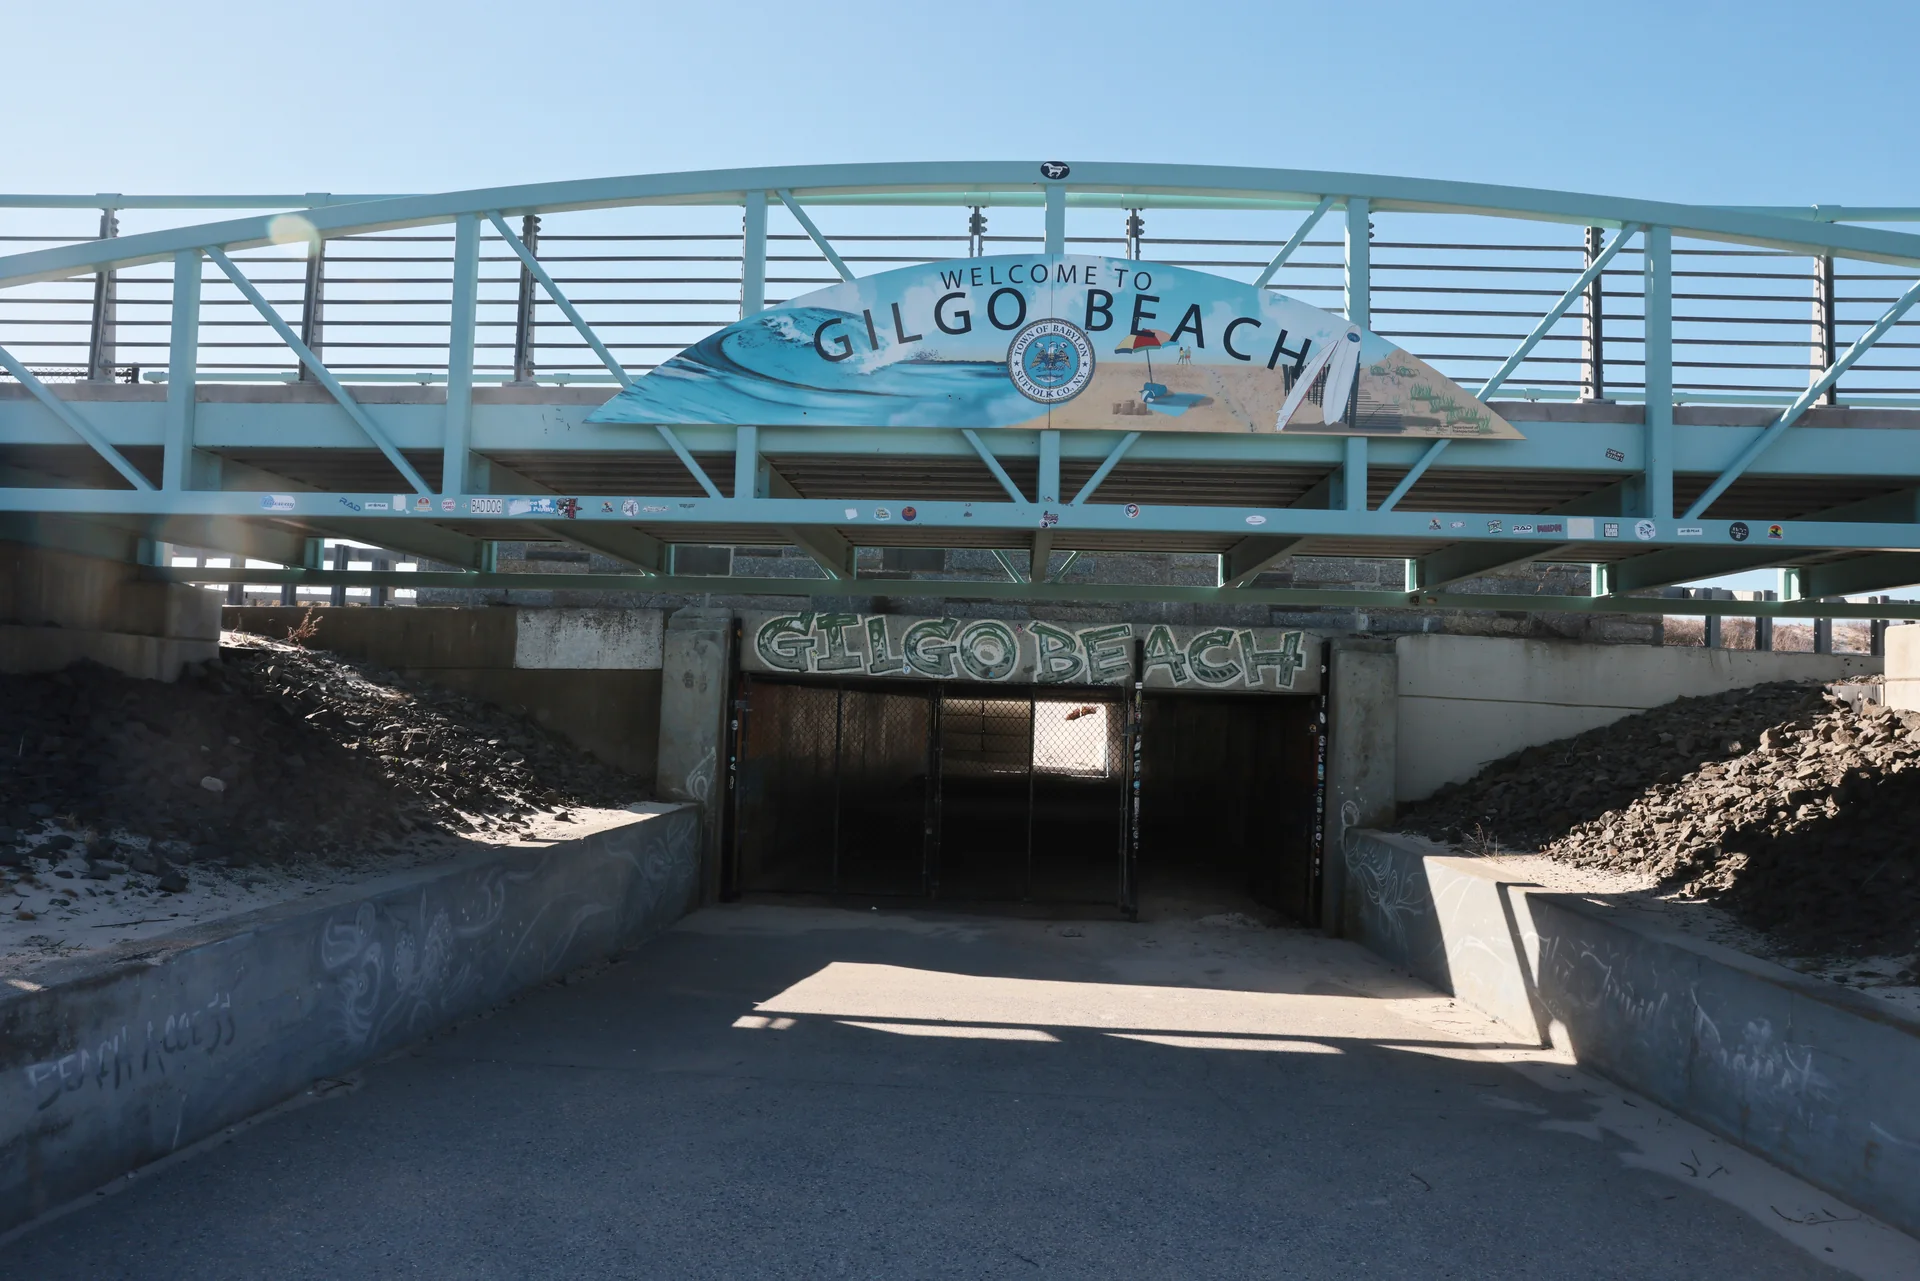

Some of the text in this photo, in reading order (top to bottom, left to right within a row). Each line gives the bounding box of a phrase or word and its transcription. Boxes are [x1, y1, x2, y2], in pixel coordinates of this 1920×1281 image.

[940, 263, 1152, 291] WELCOME TO
[814, 287, 1313, 380] GILGO BEACH
[1014, 324, 1088, 357] TOWN OF BABYLON
[1015, 370, 1054, 398] SUFFOLK
[339, 497, 361, 512] RAD
[472, 499, 485, 513] BAD
[486, 499, 502, 513] DOG
[755, 612, 1306, 690] GILGO BEACH
